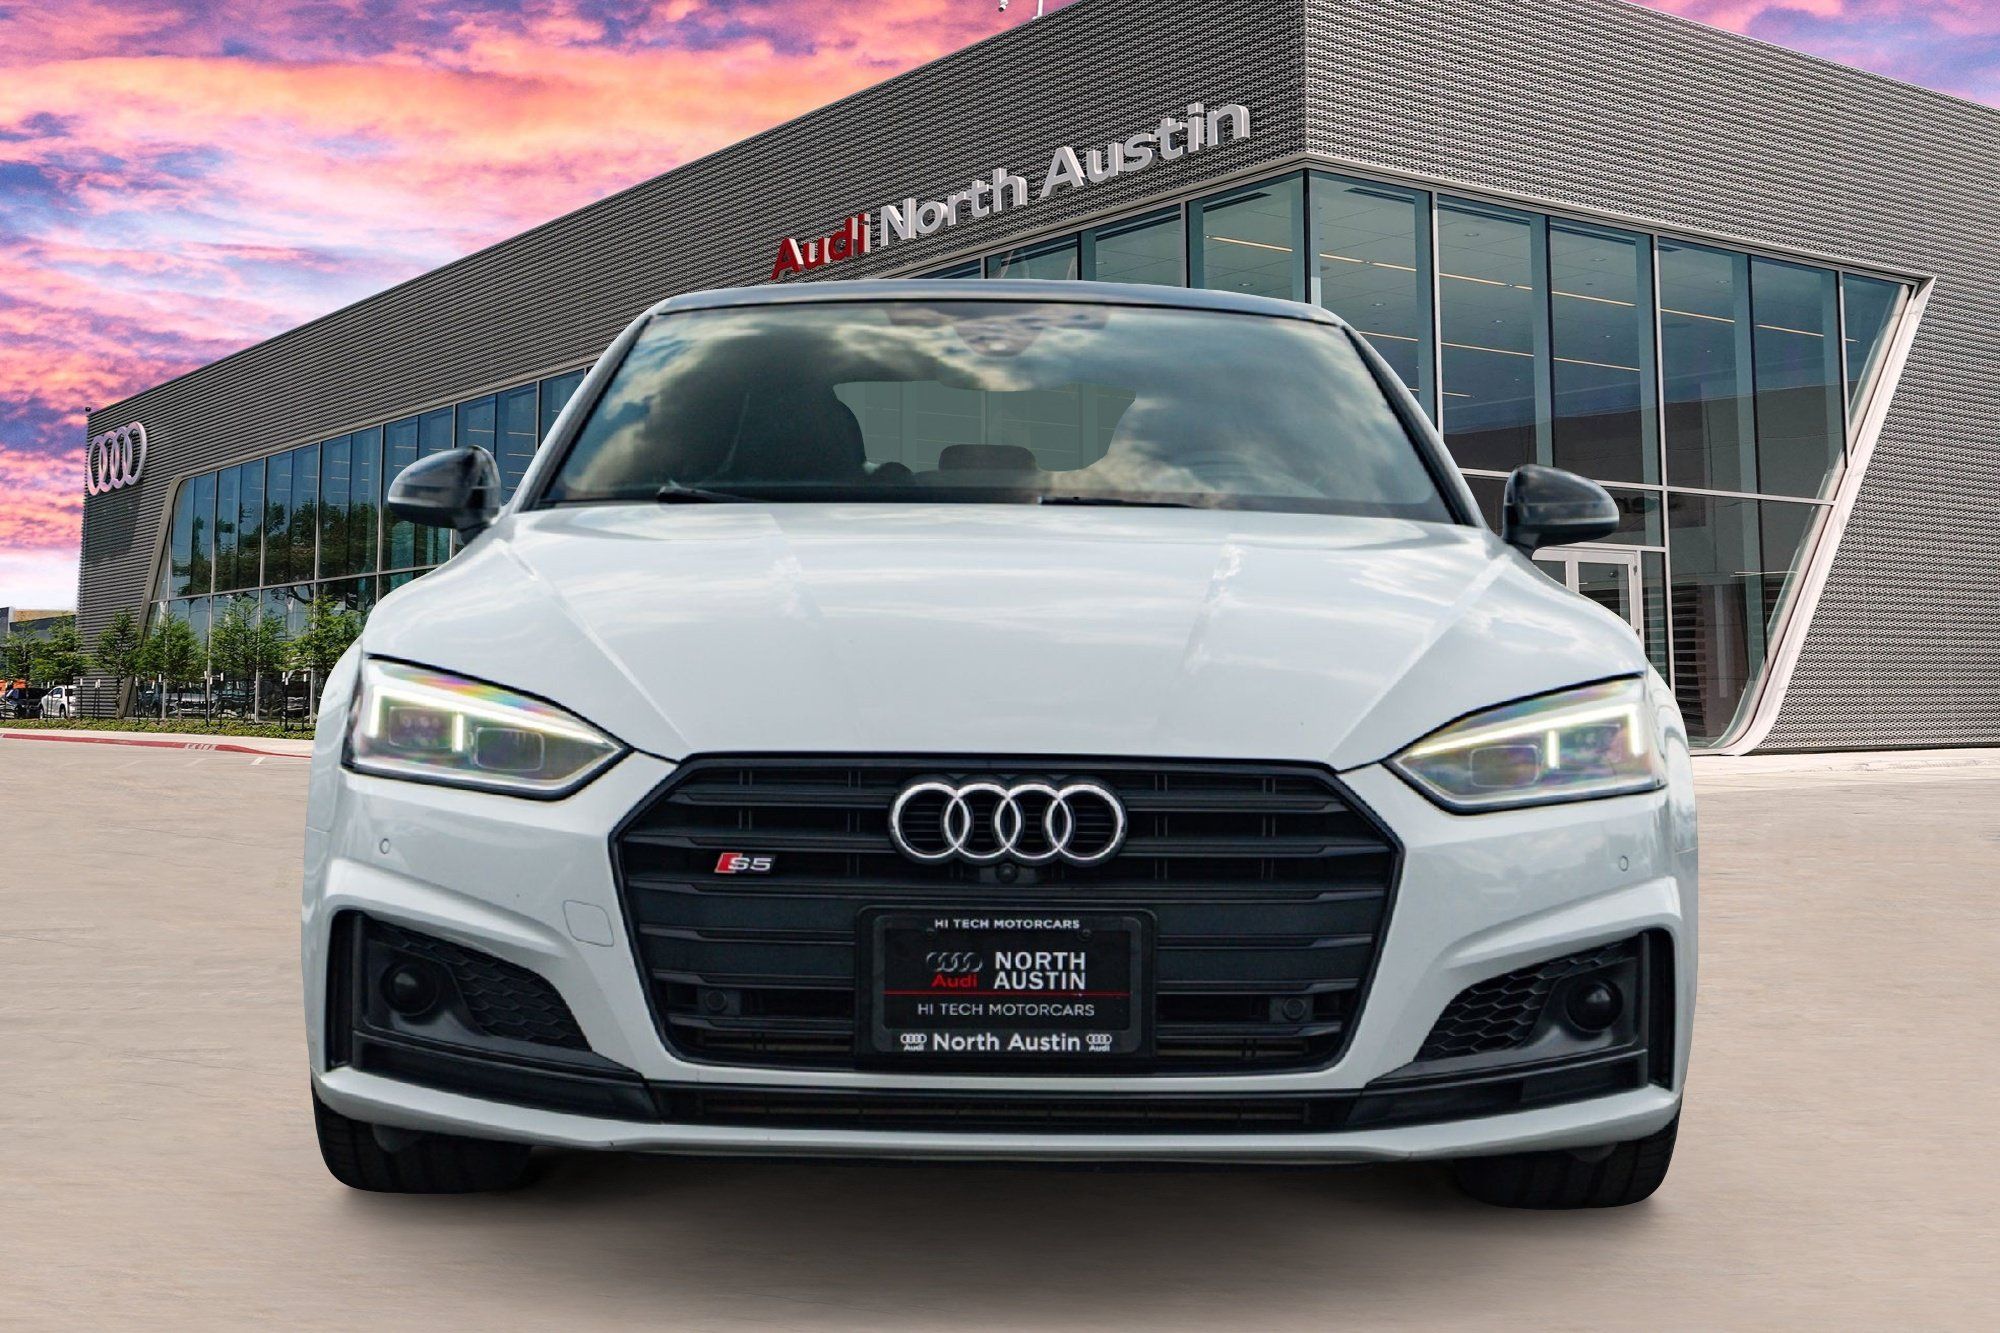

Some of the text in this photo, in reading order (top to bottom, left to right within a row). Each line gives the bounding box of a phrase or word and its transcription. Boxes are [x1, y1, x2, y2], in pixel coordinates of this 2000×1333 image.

[770, 102, 1250, 281] Audi North Austin
[727, 856, 773, 872] S5
[934, 918, 1080, 929] HI TECH MOTORCARS
[994, 951, 1087, 971] NORTH
[931, 973, 978, 989] Audi
[993, 972, 1087, 990] AUSTIN
[917, 1003, 1095, 1016] HI TECH MOTORCARS
[903, 1032, 1111, 1052] Audi North Austin Audi
